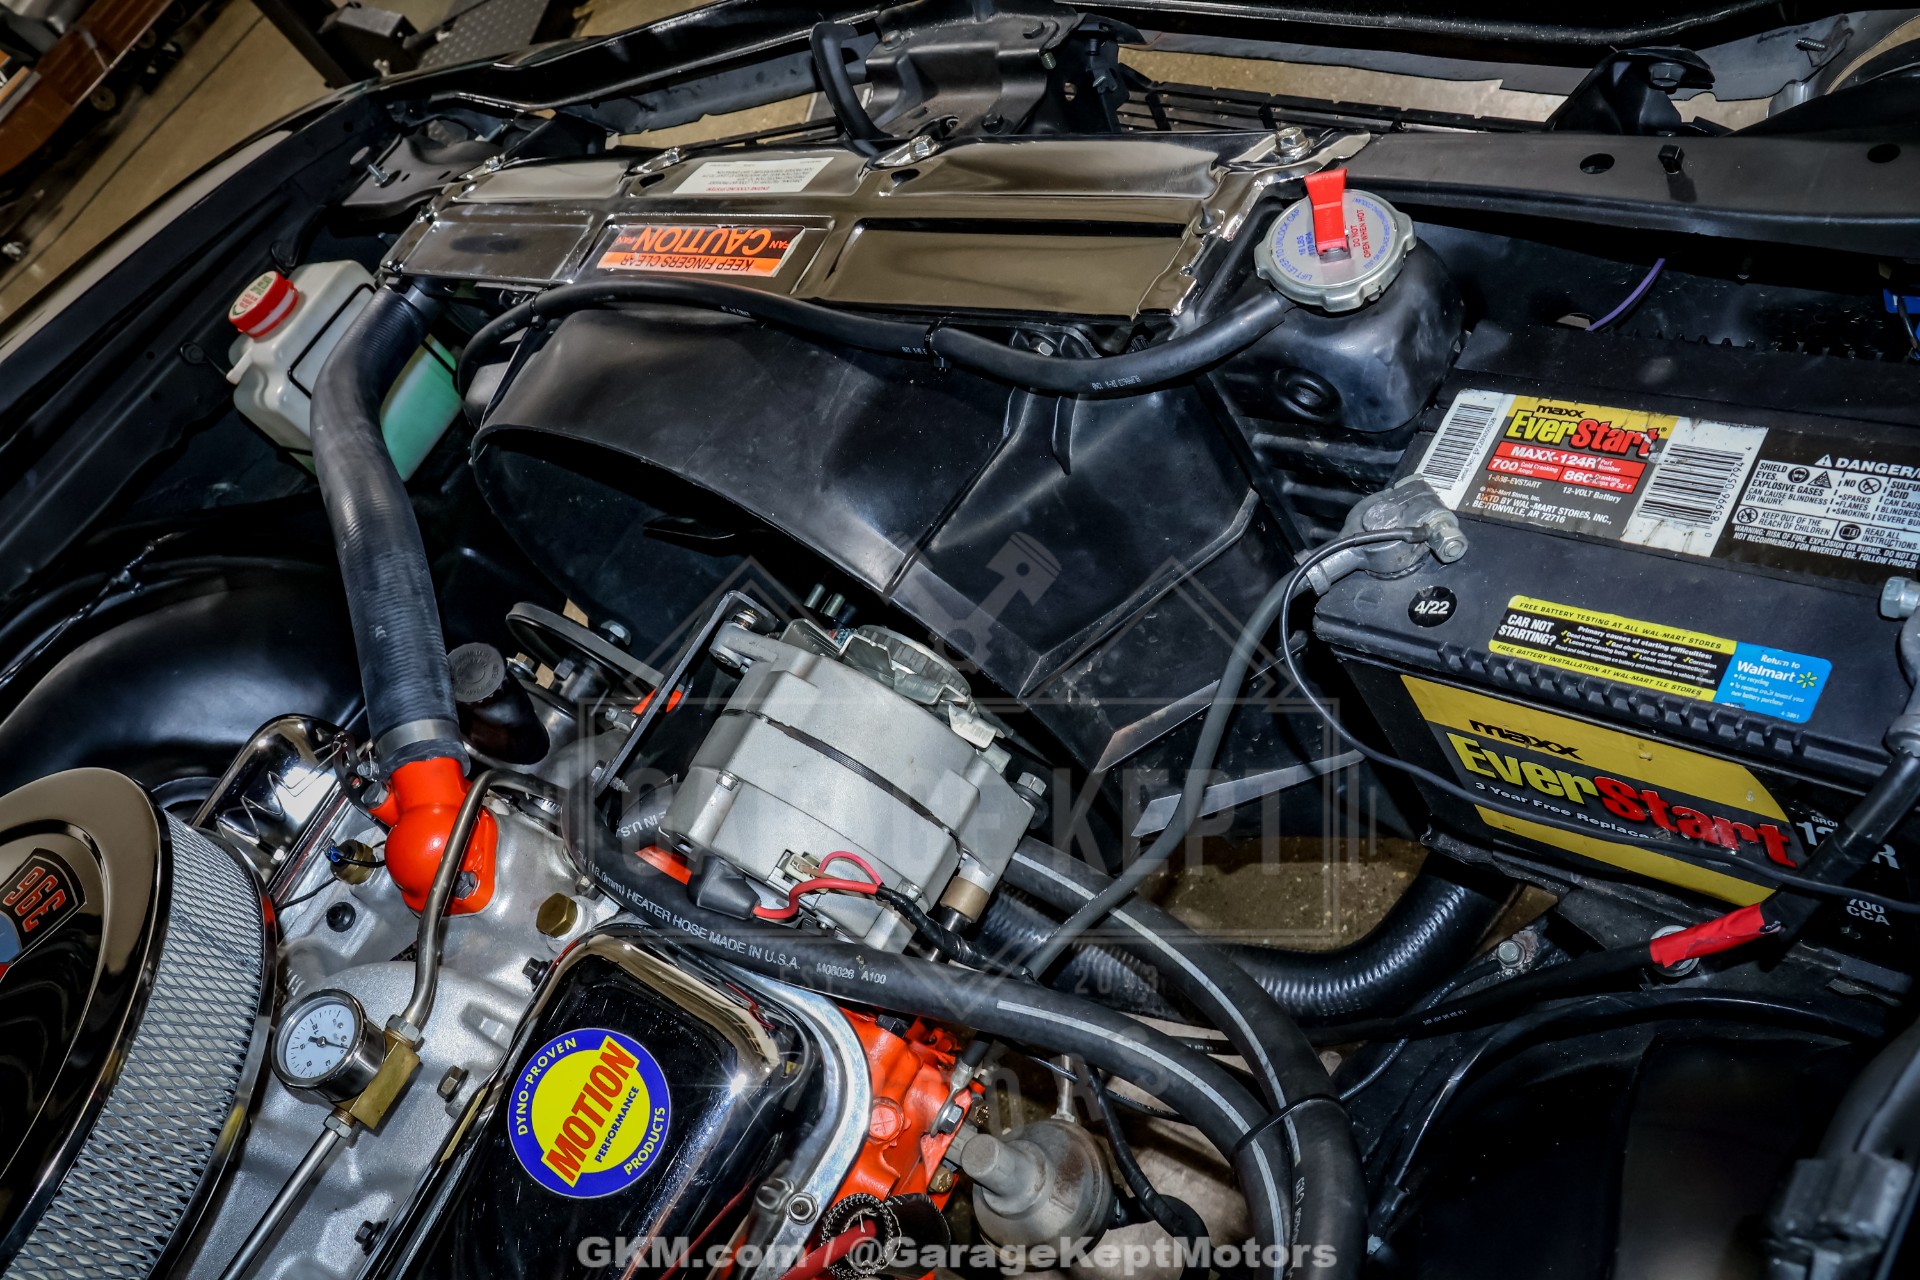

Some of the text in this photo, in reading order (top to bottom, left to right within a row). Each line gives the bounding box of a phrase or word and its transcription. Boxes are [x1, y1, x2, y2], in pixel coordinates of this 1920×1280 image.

[632, 227, 790, 256] FAN CAUTION
[1296, 235, 1305, 249] LBS
[1350, 224, 1361, 248] DO NOT
[1356, 209, 1372, 258] OPEN WHEN HOT
[1275, 209, 1313, 281] LIFT LEVER TO UNLOCK CAP
[620, 254, 754, 272] KEEP FINGERS CLEAR
[1536, 405, 1587, 419] maxx
[1505, 409, 1660, 459] EverStart
[1491, 459, 1519, 472] 700
[1510, 446, 1599, 469] MAXX-124R
[1533, 462, 1559, 474] Cranking
[1755, 470, 1778, 481] EYES.
[1758, 462, 1788, 473] SHIELD
[1710, 461, 1745, 522] 83996 05794
[1751, 479, 1825, 497] EXPLOSIVE GASES
[1843, 479, 1857, 488] NO
[1562, 486, 1622, 504] 12-VOLT Battery
[1748, 487, 1828, 506] CAN CAUSE BLINDNESS
[1756, 495, 1784, 506] INJURY.
[1841, 494, 1872, 504] SPARKS
[1883, 498, 1901, 507] CAN
[1887, 490, 1910, 500] ACID
[1472, 500, 1566, 525] BENTONVILLE, AR 72716
[1500, 496, 1513, 506] BY
[1513, 498, 1558, 513] WAL-MART
[1557, 505, 1591, 520] STORES,
[1592, 513, 1613, 525] INC.,
[1835, 507, 1871, 519] SMOKING
[1839, 500, 1869, 511] FLAMES
[1758, 518, 1832, 537] REACH OF CHILDREN.
[1761, 511, 1822, 527] KEEP OUT OF THE
[1877, 514, 1907, 525] SEVERE
[1734, 524, 1910, 560] WARNING: RISK OF EXPLOSION OR BURNS. DO NOT
[1861, 534, 1919, 551] INSTRUCTIONS.
[1864, 527, 1900, 540] READ ALL
[1733, 532, 1917, 570] NOT RECOMMENDED FOR INVERTED USE. FOLLOW PROPER
[1414, 600, 1450, 615] 4/22
[1507, 614, 1555, 633] CAR NOT
[1519, 602, 1722, 650] FREE BATTERY TESTING AT ALL WAL-MART STORES
[1498, 625, 1557, 647] STARTING?
[1566, 631, 1601, 645] Dead battery
[1577, 626, 1713, 660] Primary causes of starting difficulties:
[1568, 638, 1614, 655] Loose missing
[1611, 641, 1678, 661] Bad alternator starter
[1496, 644, 1703, 696] FREE BATTERY INSTALLATION AT WAL-MART TLE STORES
[1639, 654, 1657, 663] Loose
[1656, 658, 1673, 667] cable
[1760, 654, 1801, 669] Return to
[1737, 660, 1796, 683] Walmart
[1746, 676, 1770, 687] recycling
[1741, 692, 1760, 702] battery
[1468, 719, 1585, 761] maxx
[1445, 730, 1797, 869] EverStart
[1474, 781, 1487, 792] 3
[1489, 785, 1529, 805] Year
[1532, 798, 1573, 817] Free
[2, 866, 67, 933] 396
[1846, 905, 1891, 926] CCA
[626, 882, 672, 923] HEATER
[672, 911, 708, 941] HOSE
[708, 929, 746, 956] MADE
[748, 945, 762, 961] IN
[764, 947, 801, 971] U.S.A.
[860, 968, 887, 985] A100
[516, 1037, 578, 1136] DYNO-PROVEN
[545, 1041, 636, 1182] MOTION
[594, 1085, 640, 1164] PERFORMANCE
[623, 1107, 666, 1176] PRODUCTS
